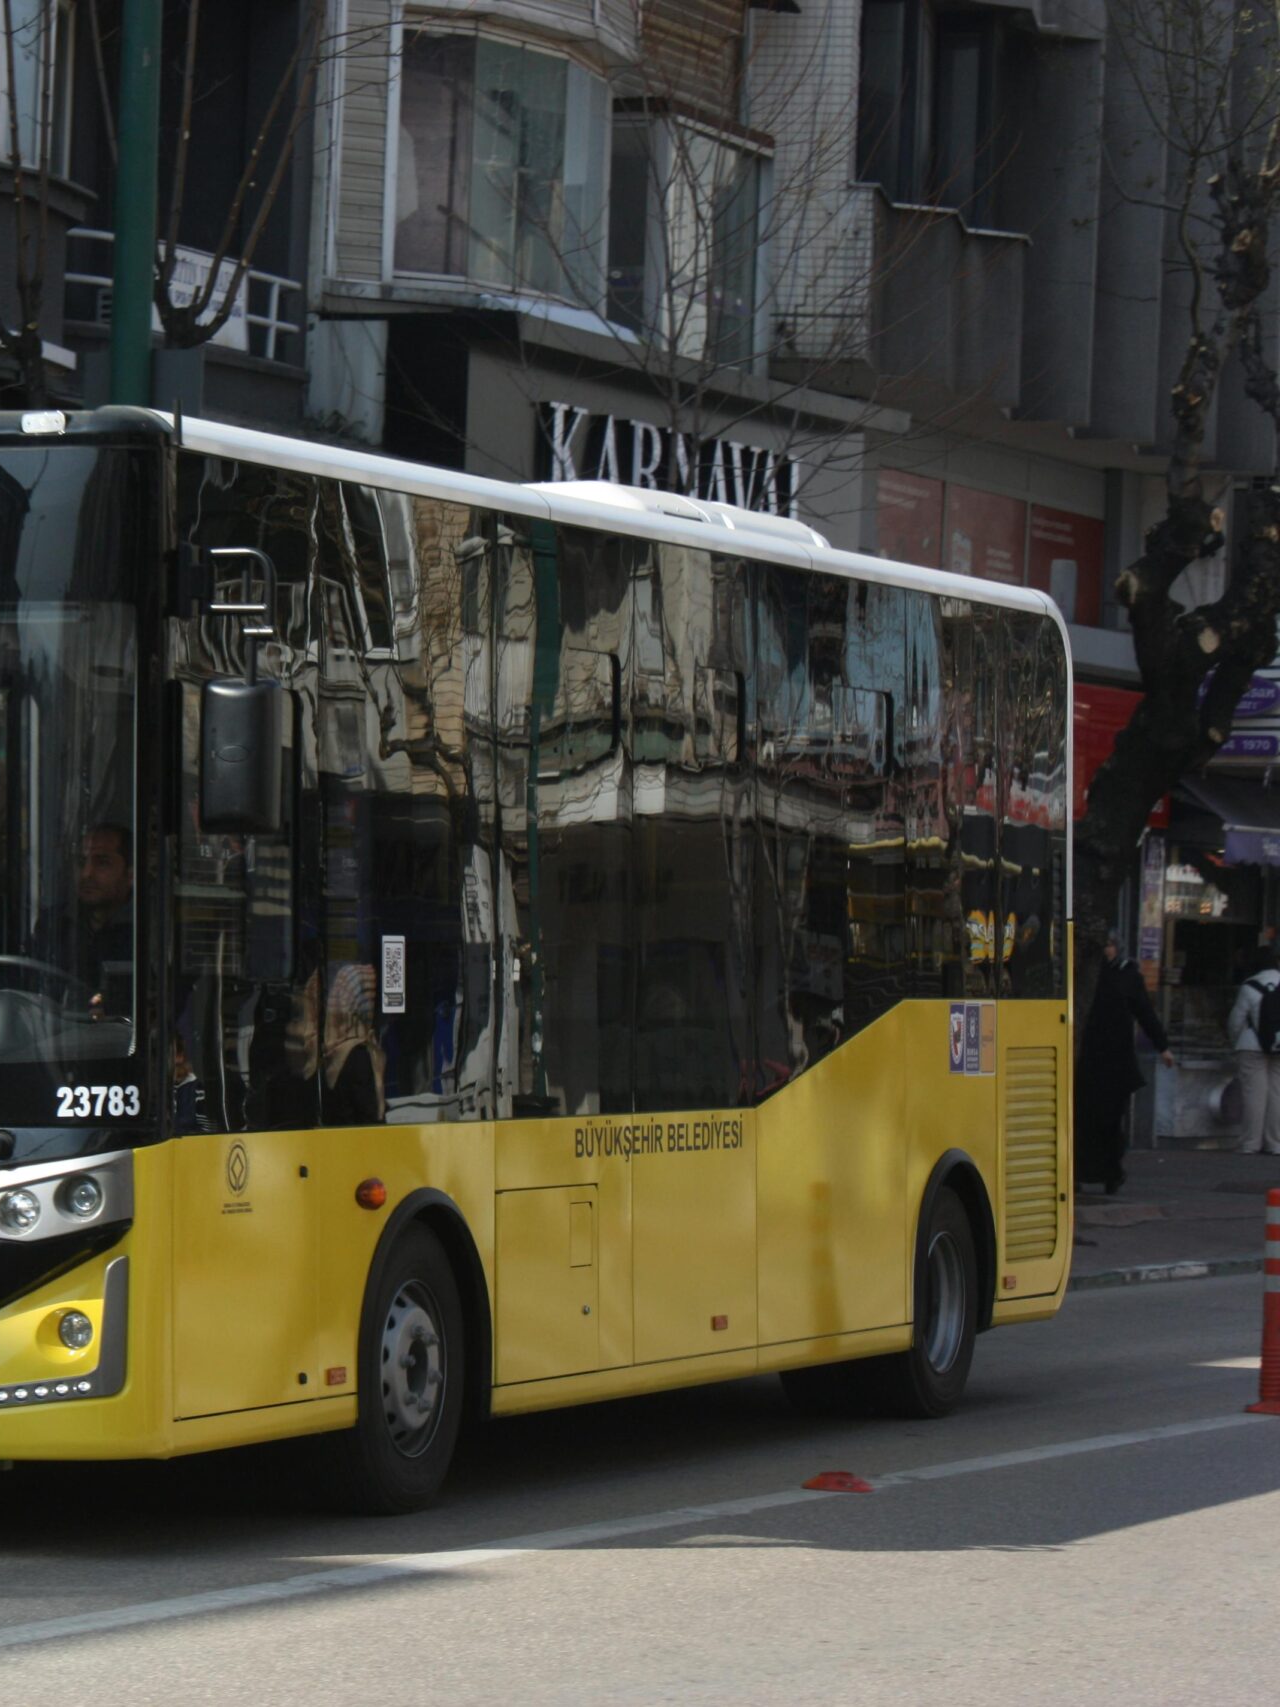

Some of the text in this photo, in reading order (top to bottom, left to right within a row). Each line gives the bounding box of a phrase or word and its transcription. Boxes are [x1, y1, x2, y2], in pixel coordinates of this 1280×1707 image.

[56, 1085, 141, 1118] 23783
[575, 1113, 743, 1163] BÜYÜKŞEHİR BELEDİYESİ
